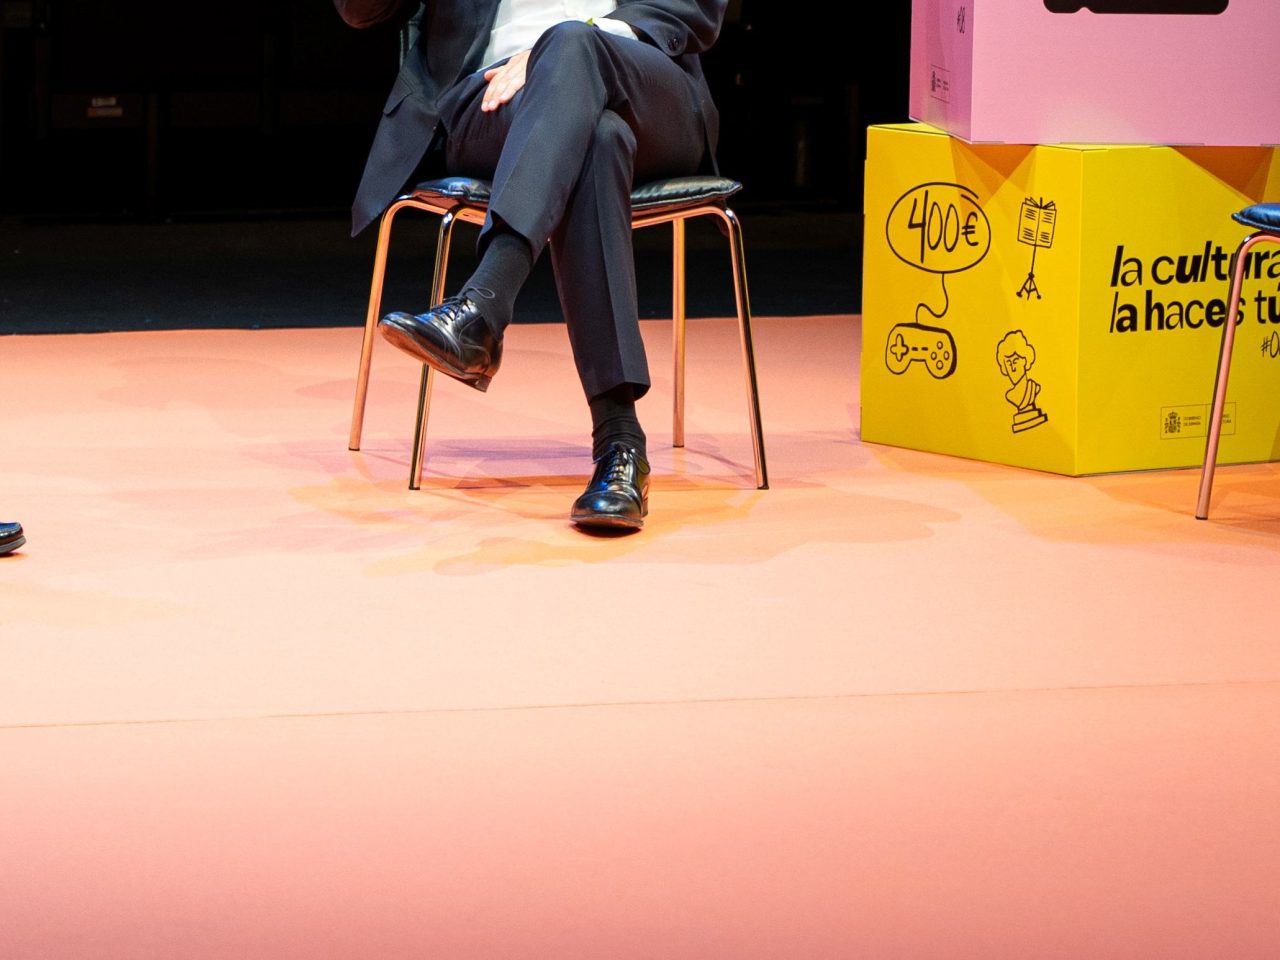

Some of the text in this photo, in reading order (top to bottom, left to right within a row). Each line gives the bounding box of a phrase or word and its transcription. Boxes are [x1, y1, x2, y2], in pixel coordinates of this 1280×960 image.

[907, 190, 979, 263] 400€
[1110, 245, 1142, 287] la
[1109, 291, 1138, 333] la
[1261, 330, 1280, 359] #0
